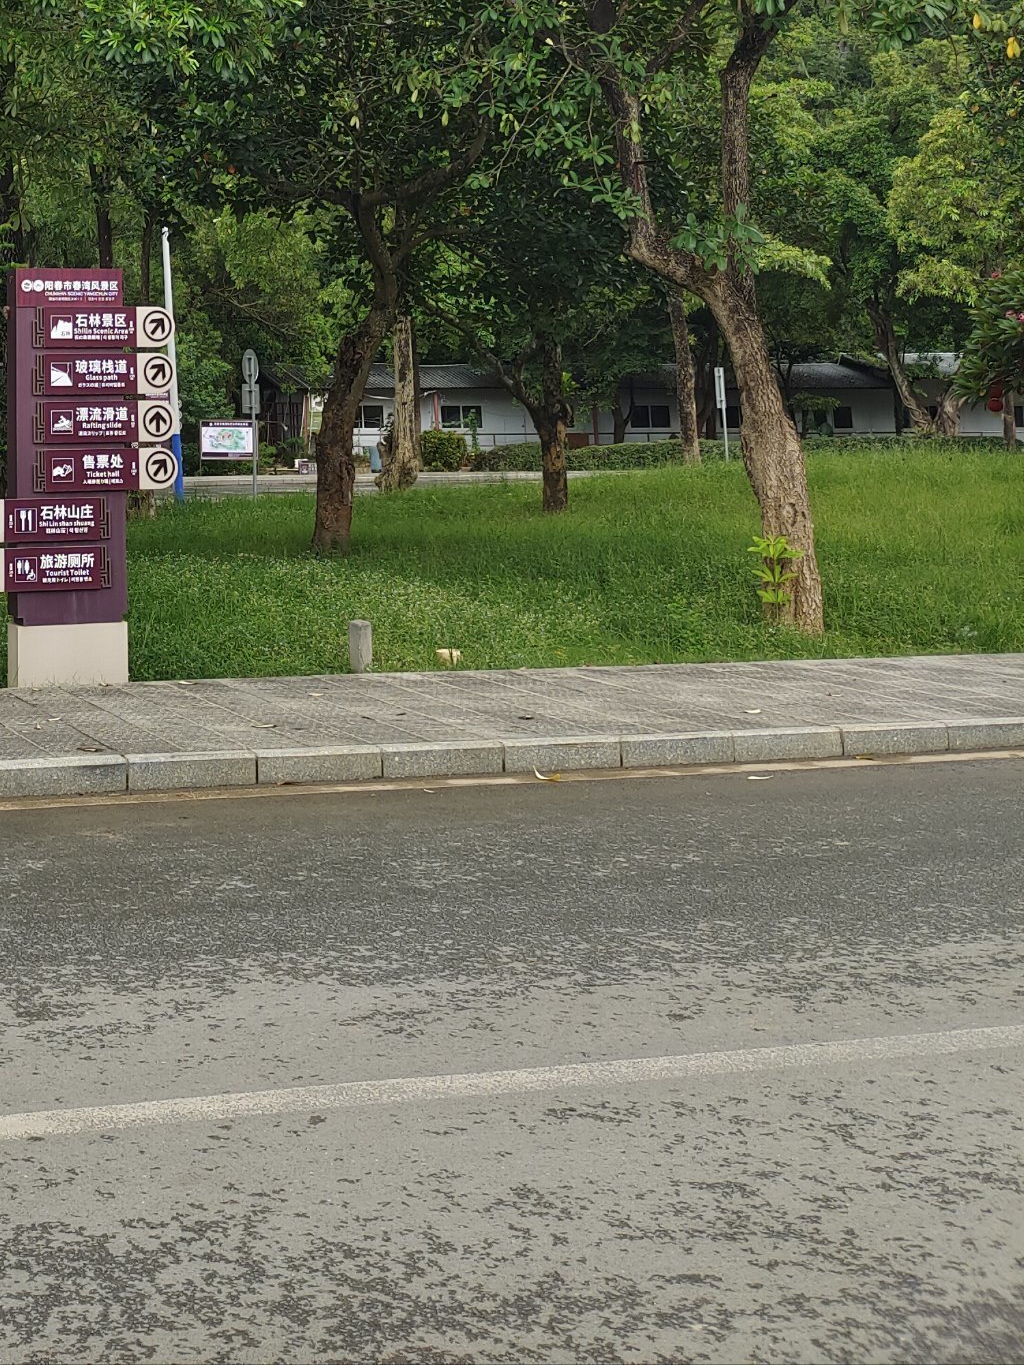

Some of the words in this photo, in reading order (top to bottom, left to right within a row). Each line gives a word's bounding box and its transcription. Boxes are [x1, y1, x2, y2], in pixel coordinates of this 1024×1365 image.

[44, 280, 119, 291] 阳春市春湾风景区
[75, 313, 127, 328] 石林景区
[93, 327, 113, 335] Scenic
[114, 327, 129, 335] Area
[75, 359, 128, 374] 玻璃栈道
[103, 374, 118, 382] path
[76, 407, 128, 421] 漂流滑道
[82, 421, 106, 430] Rafting
[106, 421, 122, 429] slide
[82, 454, 124, 470] 售票处
[86, 470, 107, 478] Ticket
[107, 470, 120, 478] hall
[40, 504, 94, 520] 石林山庄
[40, 553, 94, 569] 旅游厕所
[45, 569, 70, 577] Tourist
[70, 568, 90, 576] Toilet
